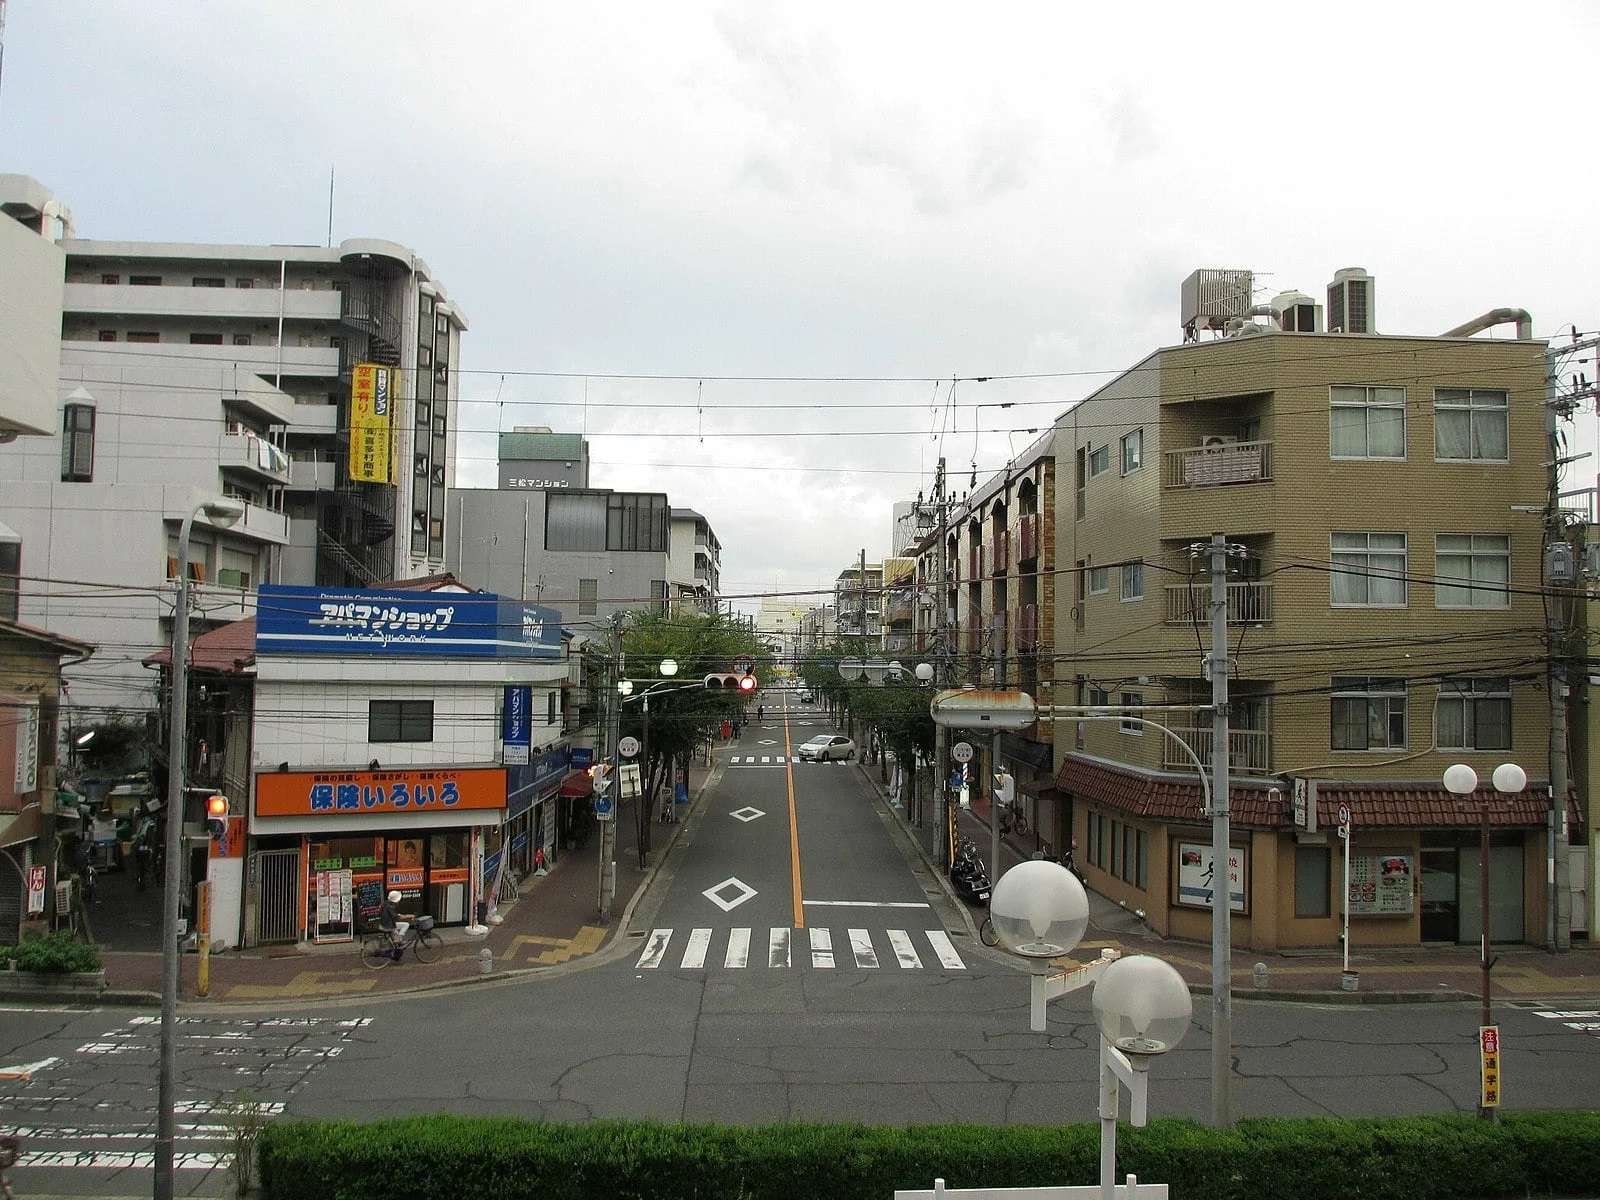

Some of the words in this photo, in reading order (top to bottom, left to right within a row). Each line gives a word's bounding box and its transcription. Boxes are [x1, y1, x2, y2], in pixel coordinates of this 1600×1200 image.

[508, 477, 570, 488] 三松マンション
[320, 603, 455, 631] アパマンショップ
[309, 782, 460, 811] 保険いろいろ
